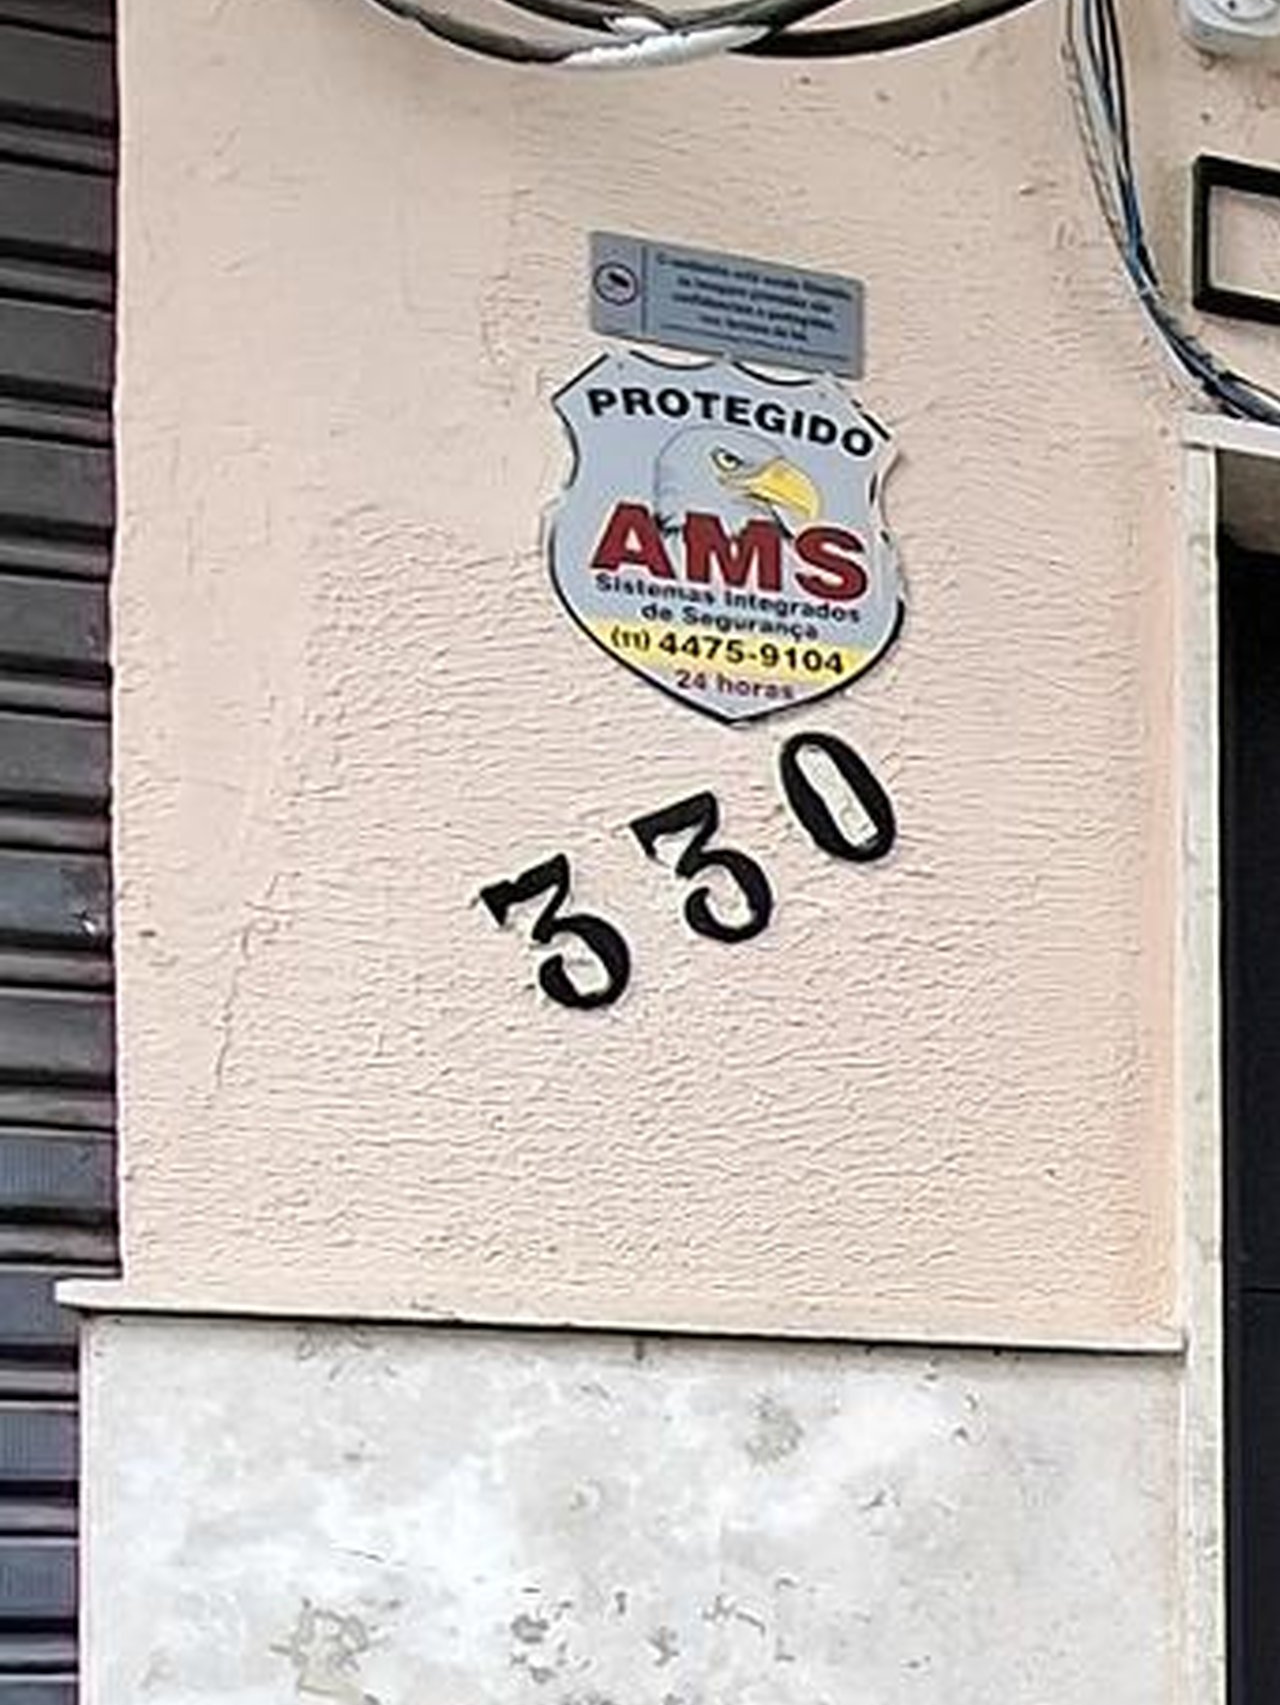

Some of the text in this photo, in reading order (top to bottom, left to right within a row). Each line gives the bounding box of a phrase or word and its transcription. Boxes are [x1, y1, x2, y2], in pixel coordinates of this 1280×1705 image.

[587, 387, 874, 457] PROTEGIDO
[590, 502, 868, 601] AMS
[595, 573, 861, 624] Sistemas Integrados
[641, 602, 819, 642] de Segurança
[610, 626, 845, 675] (11) 4475-9104
[674, 668, 794, 700] 24 horas
[480, 730, 898, 1010] 330
